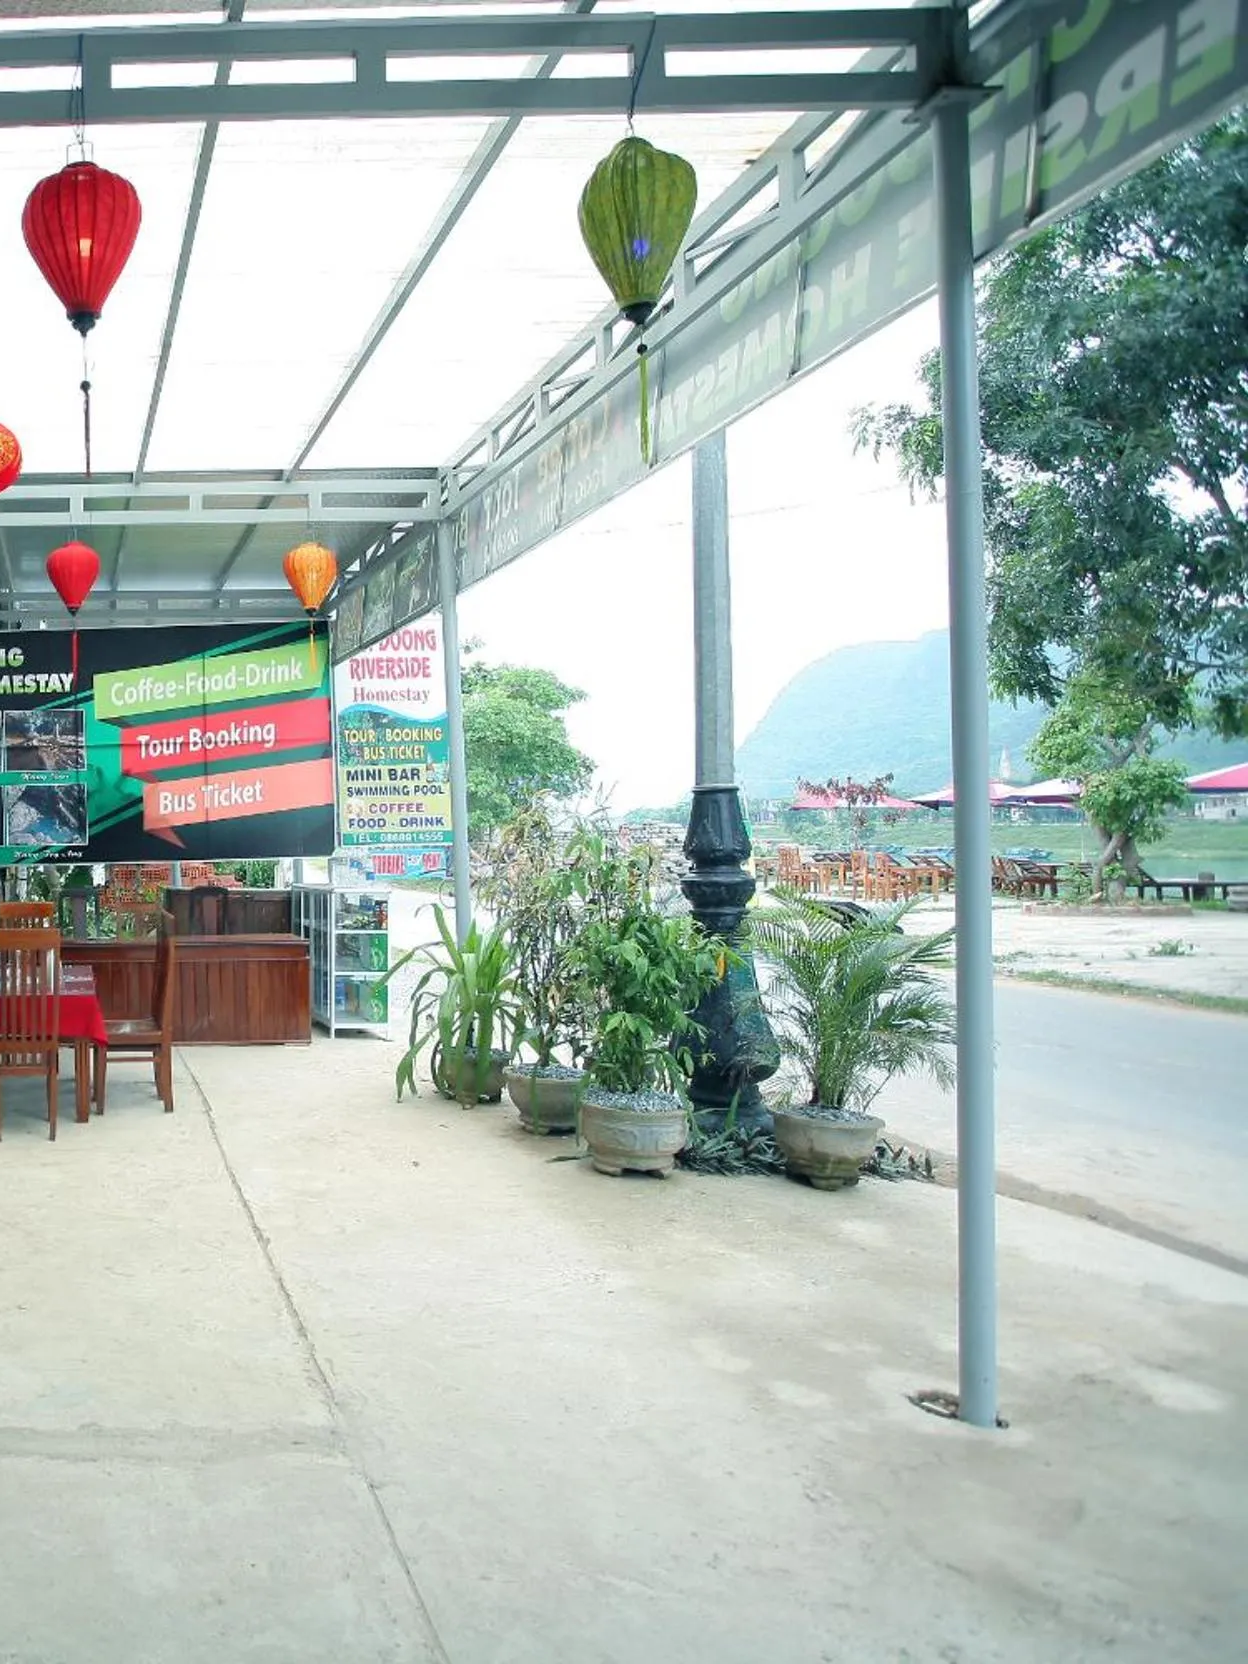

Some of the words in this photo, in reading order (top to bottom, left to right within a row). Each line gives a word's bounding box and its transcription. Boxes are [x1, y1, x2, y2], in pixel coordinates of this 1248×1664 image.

[349, 656, 432, 682] RIVERSIDE
[111, 656, 303, 706] Coffee-Food-Drink
[353, 687, 430, 704] Homestay
[137, 734, 184, 759] Tour
[189, 720, 275, 748] Booking
[344, 729, 376, 744] TOUR
[385, 727, 443, 742] BOOKING
[363, 747, 385, 760] BUS
[389, 745, 425, 760] TICKET
[346, 769, 382, 782] MINI
[388, 768, 421, 781] BAR
[159, 790, 196, 815] Bus
[202, 780, 264, 808] Ticket
[347, 786, 410, 797] SWIMMING
[414, 785, 444, 796] POOL
[369, 802, 424, 814] COFFEE
[348, 818, 386, 829] FOOD
[399, 816, 444, 828] DRINK
